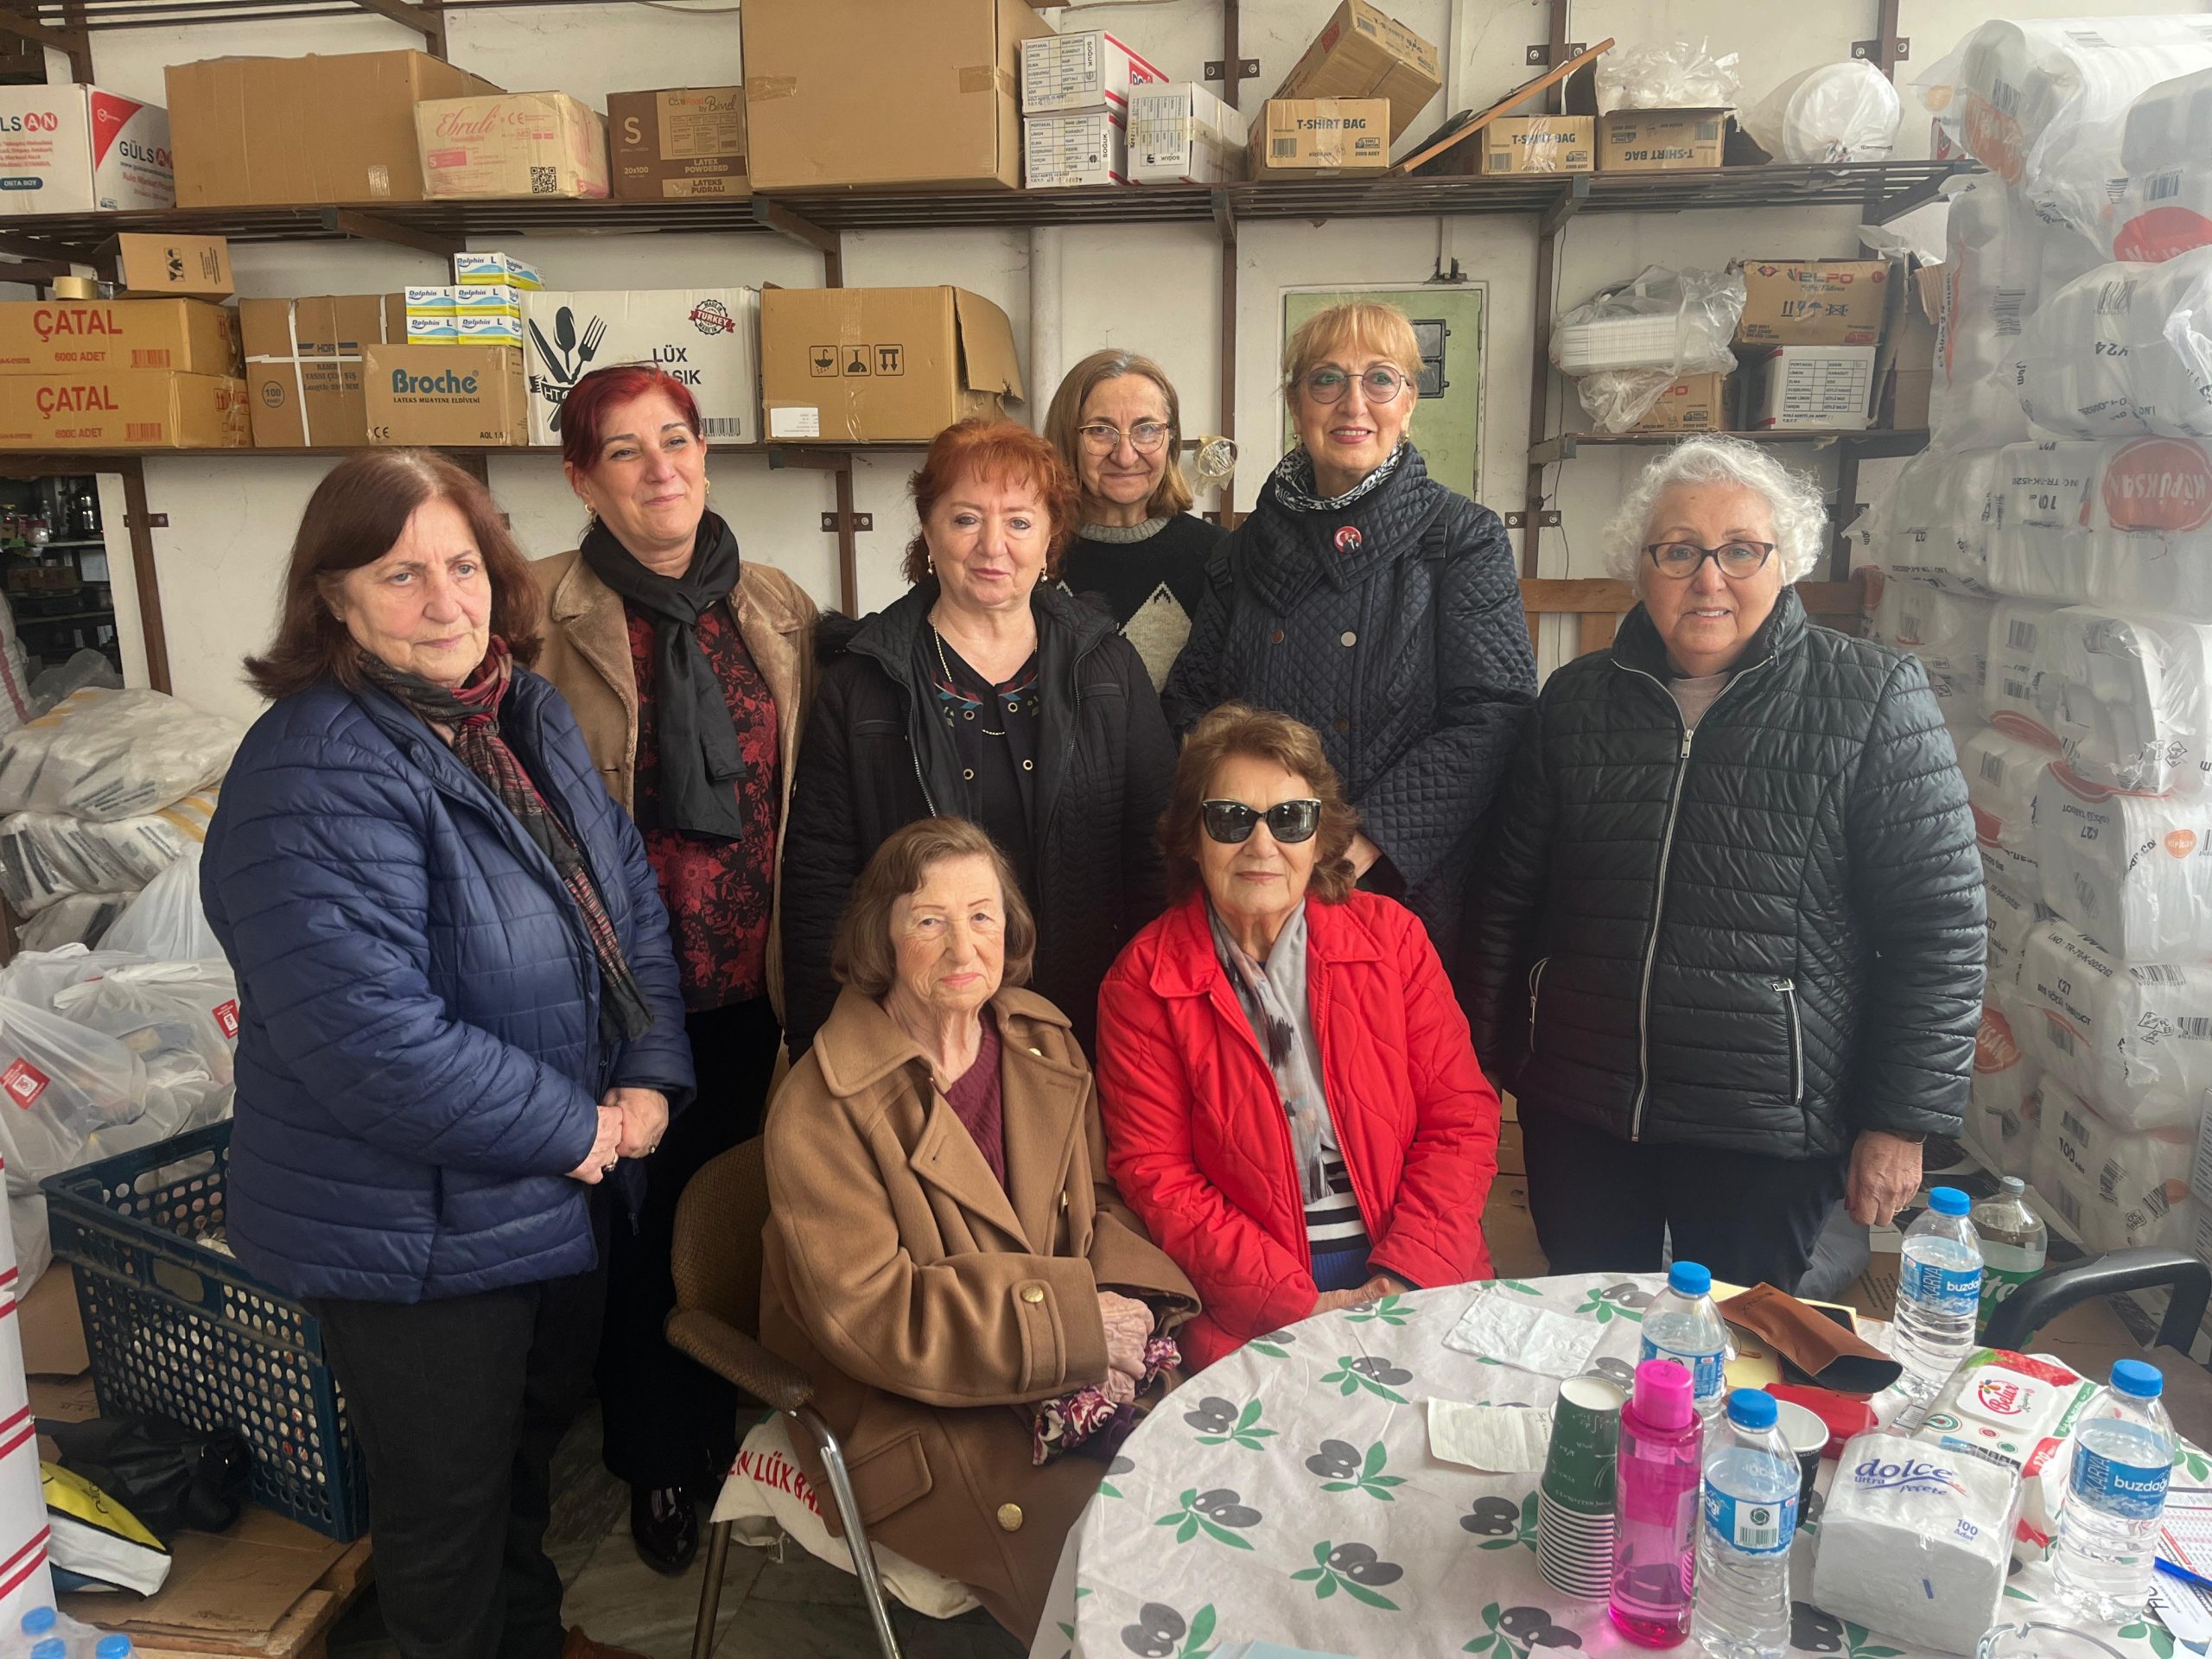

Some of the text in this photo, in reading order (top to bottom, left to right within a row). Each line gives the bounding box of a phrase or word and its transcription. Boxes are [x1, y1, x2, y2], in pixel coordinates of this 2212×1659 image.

[624, 117, 642, 144] S
[1297, 118, 1366, 130] T-SHIRT BAG
[1554, 133, 1576, 143] BAG
[1624, 149, 1694, 162] T-SHIRT BAG
[624, 166, 649, 175] 20x100
[685, 164, 729, 174] POWDERED
[691, 185, 726, 194] PUDRALI
[34, 309, 123, 342] ÇATAL
[697, 310, 728, 327] TURKEY
[54, 351, 106, 362] 6000 ADET
[652, 345, 688, 363] LÜX
[392, 369, 478, 393] Broche
[36, 385, 119, 420] ÇATAL
[79, 428, 103, 438] ADET
[2059, 1136, 2075, 1162] 100
[1988, 1382, 2020, 1412] Belux
[753, 1451, 794, 1494] LÜX
[1855, 1459, 1953, 1479] dolce
[1854, 1476, 1885, 1484] Ultra
[1954, 1529, 1974, 1541] Adet
[1957, 1518, 1979, 1535] 100
